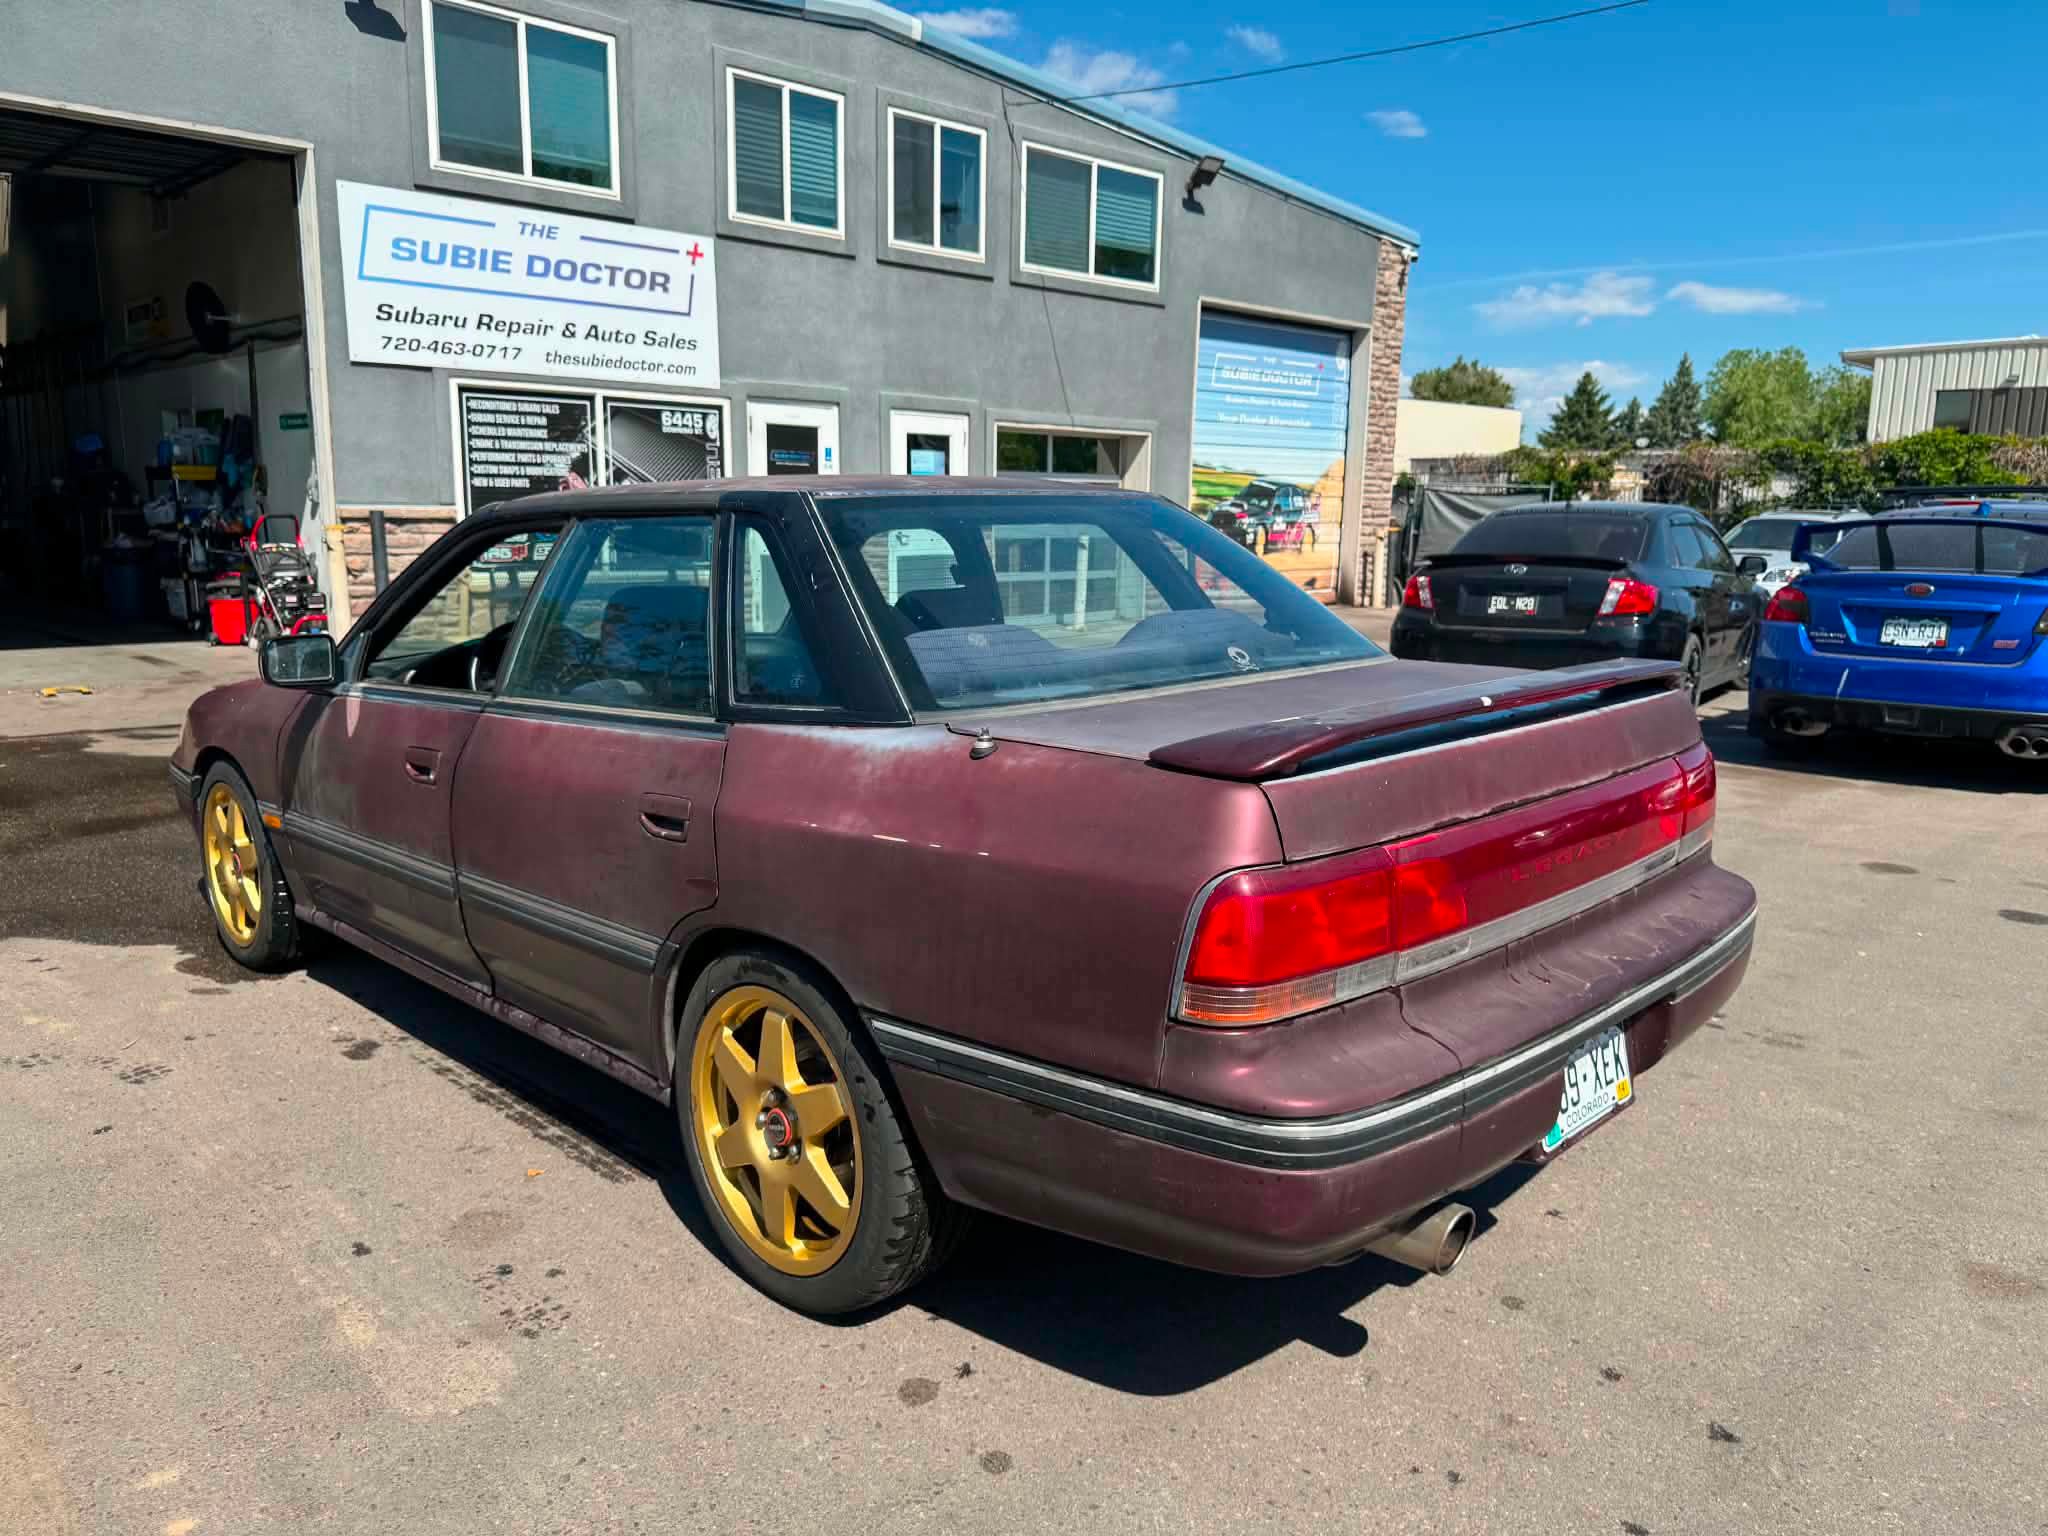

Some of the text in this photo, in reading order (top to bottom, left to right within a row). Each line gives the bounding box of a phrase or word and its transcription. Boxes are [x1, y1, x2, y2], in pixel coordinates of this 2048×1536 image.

[518, 221, 560, 240] THE
[391, 236, 671, 294] SUBIE DOCTOR
[375, 303, 698, 351] Subaru Repair & Auto Sales
[381, 335, 524, 361] 720-463-0717
[545, 350, 698, 376] thesubiedoctor.com
[661, 410, 704, 429] 6445
[1566, 1092, 1609, 1128] COLORADO
